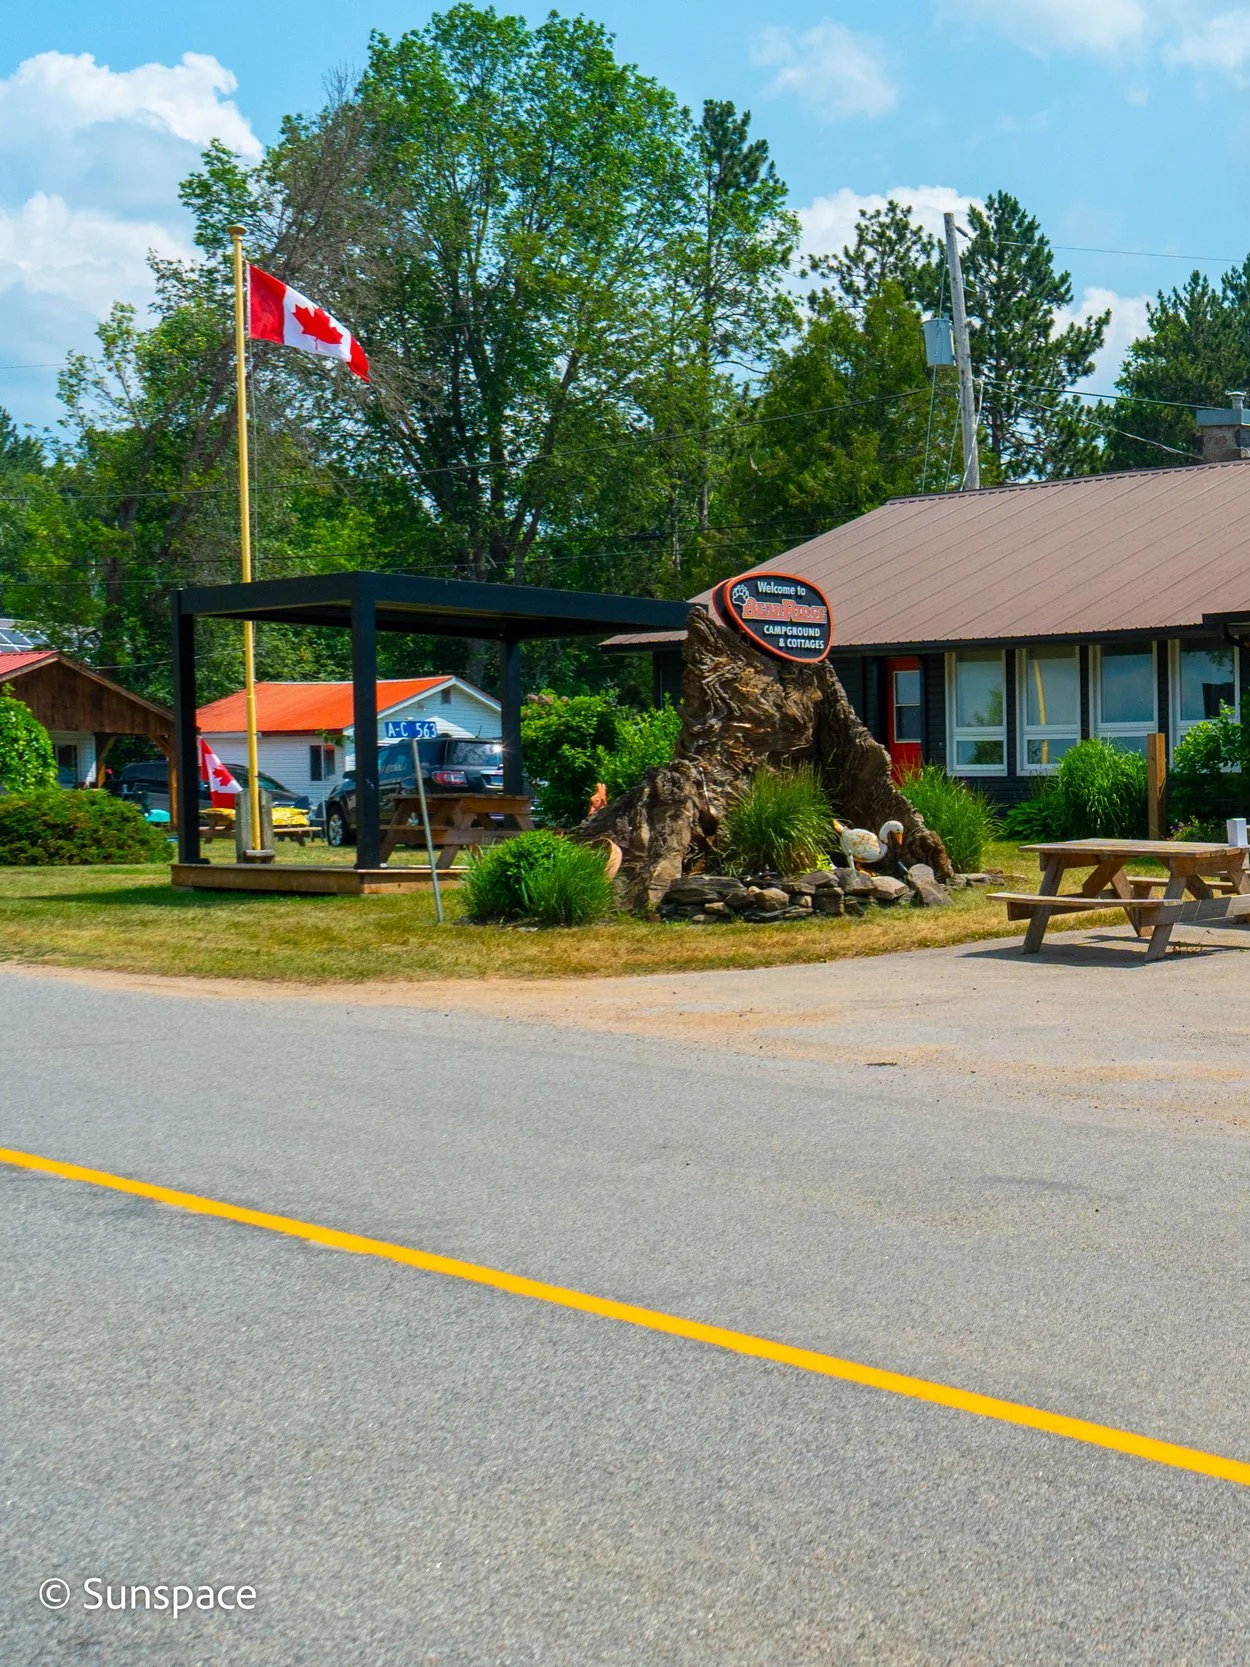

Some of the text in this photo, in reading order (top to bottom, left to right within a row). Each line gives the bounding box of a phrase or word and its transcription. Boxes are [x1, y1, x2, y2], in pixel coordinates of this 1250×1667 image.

[757, 581, 806, 596] Welcome to
[763, 625, 821, 637] CAMPGROUND
[778, 638, 825, 649] & COTTAGES
[388, 721, 437, 738] A-C 563
